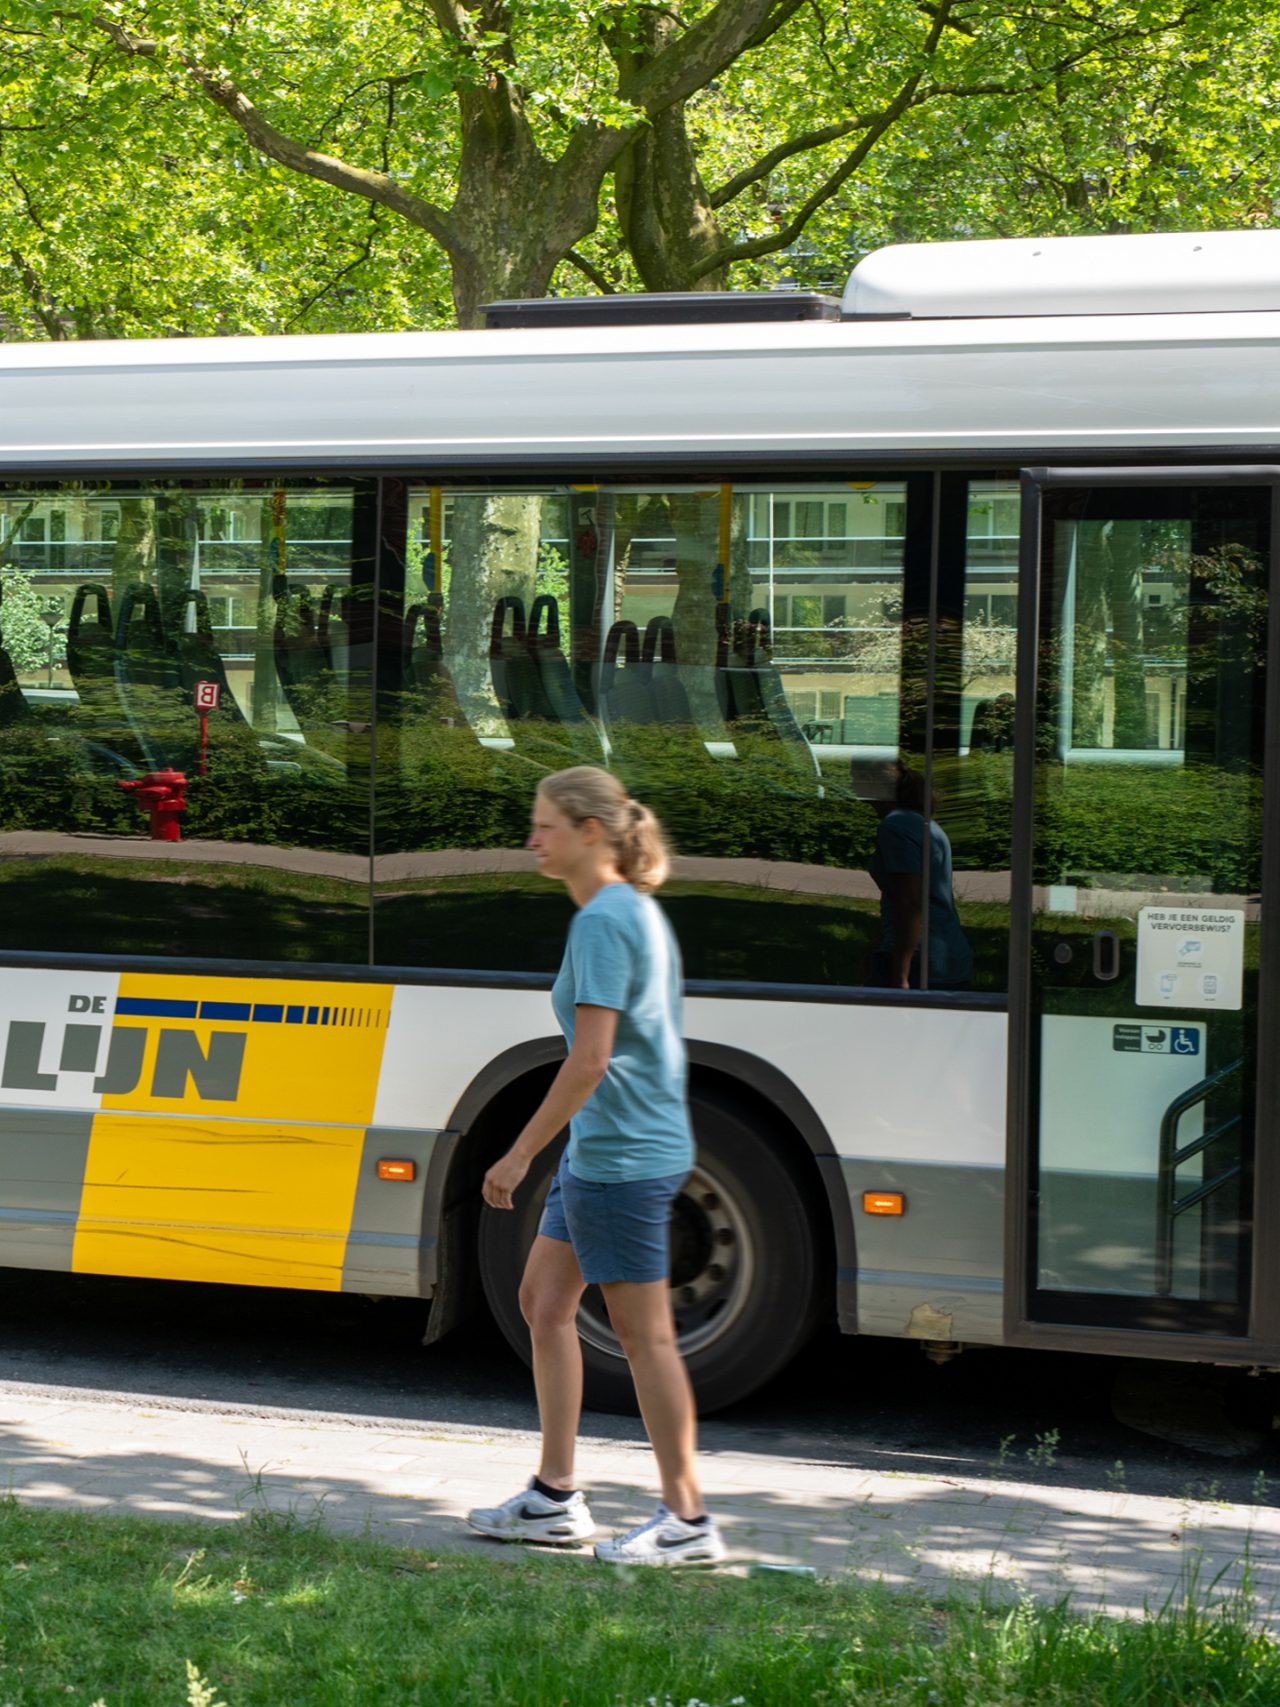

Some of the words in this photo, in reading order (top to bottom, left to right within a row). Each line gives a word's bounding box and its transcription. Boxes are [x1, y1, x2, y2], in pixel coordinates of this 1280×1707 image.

[1147, 912, 1166, 922] HEB
[1169, 913, 1179, 922] JE
[1181, 914, 1199, 923] EEN
[1201, 914, 1236, 924] GELDIG
[1151, 923, 1231, 932] VERVOERBEWIJS?
[68, 994, 107, 1014] DE
[1, 1020, 247, 1102] LIJN
